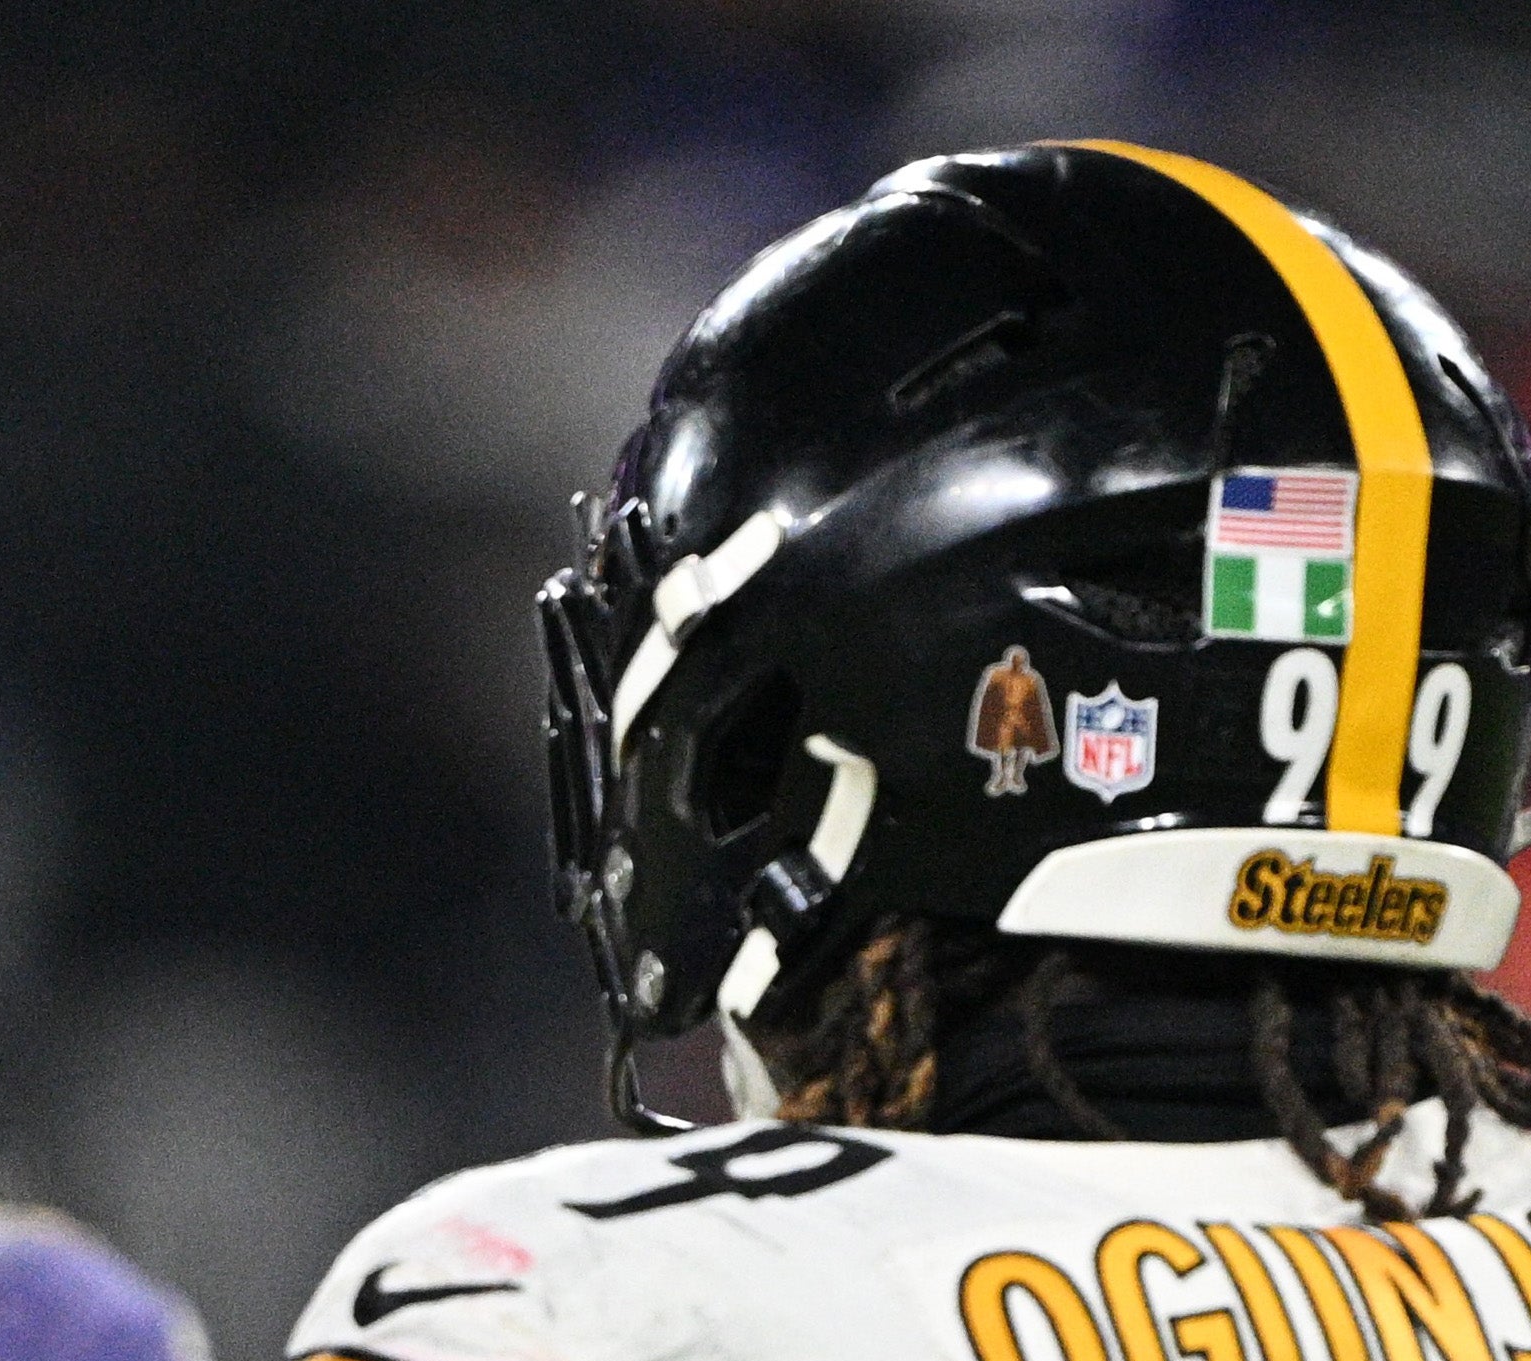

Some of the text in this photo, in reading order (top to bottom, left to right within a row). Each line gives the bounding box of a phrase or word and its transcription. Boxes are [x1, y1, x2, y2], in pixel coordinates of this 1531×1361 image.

[1079, 731, 1144, 783] NFL
[1260, 647, 1473, 837] 99
[1228, 848, 1450, 944] Steelers
